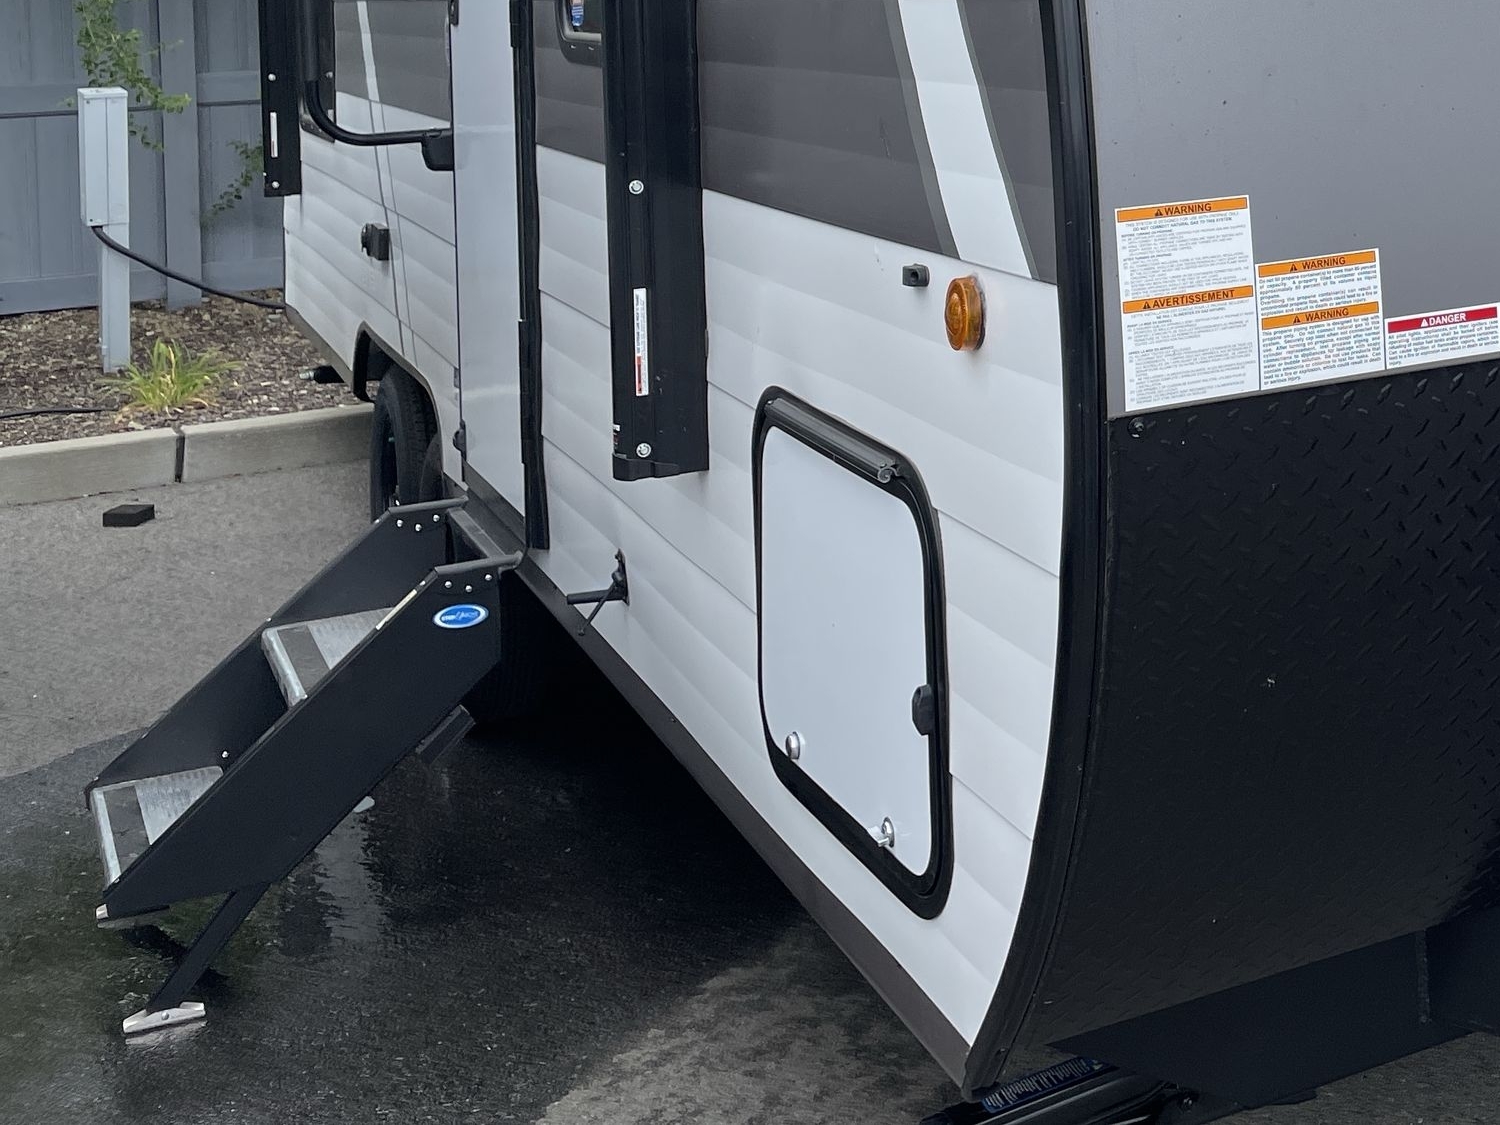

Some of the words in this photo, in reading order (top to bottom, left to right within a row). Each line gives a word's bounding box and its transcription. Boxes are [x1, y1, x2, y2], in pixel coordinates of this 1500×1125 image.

[1165, 203, 1212, 215] WARNING
[1302, 256, 1346, 270] WARNING
[1153, 289, 1235, 308] AVERTISSEMENT
[1305, 308, 1349, 322] WARNING
[1429, 312, 1466, 326] DANGER
